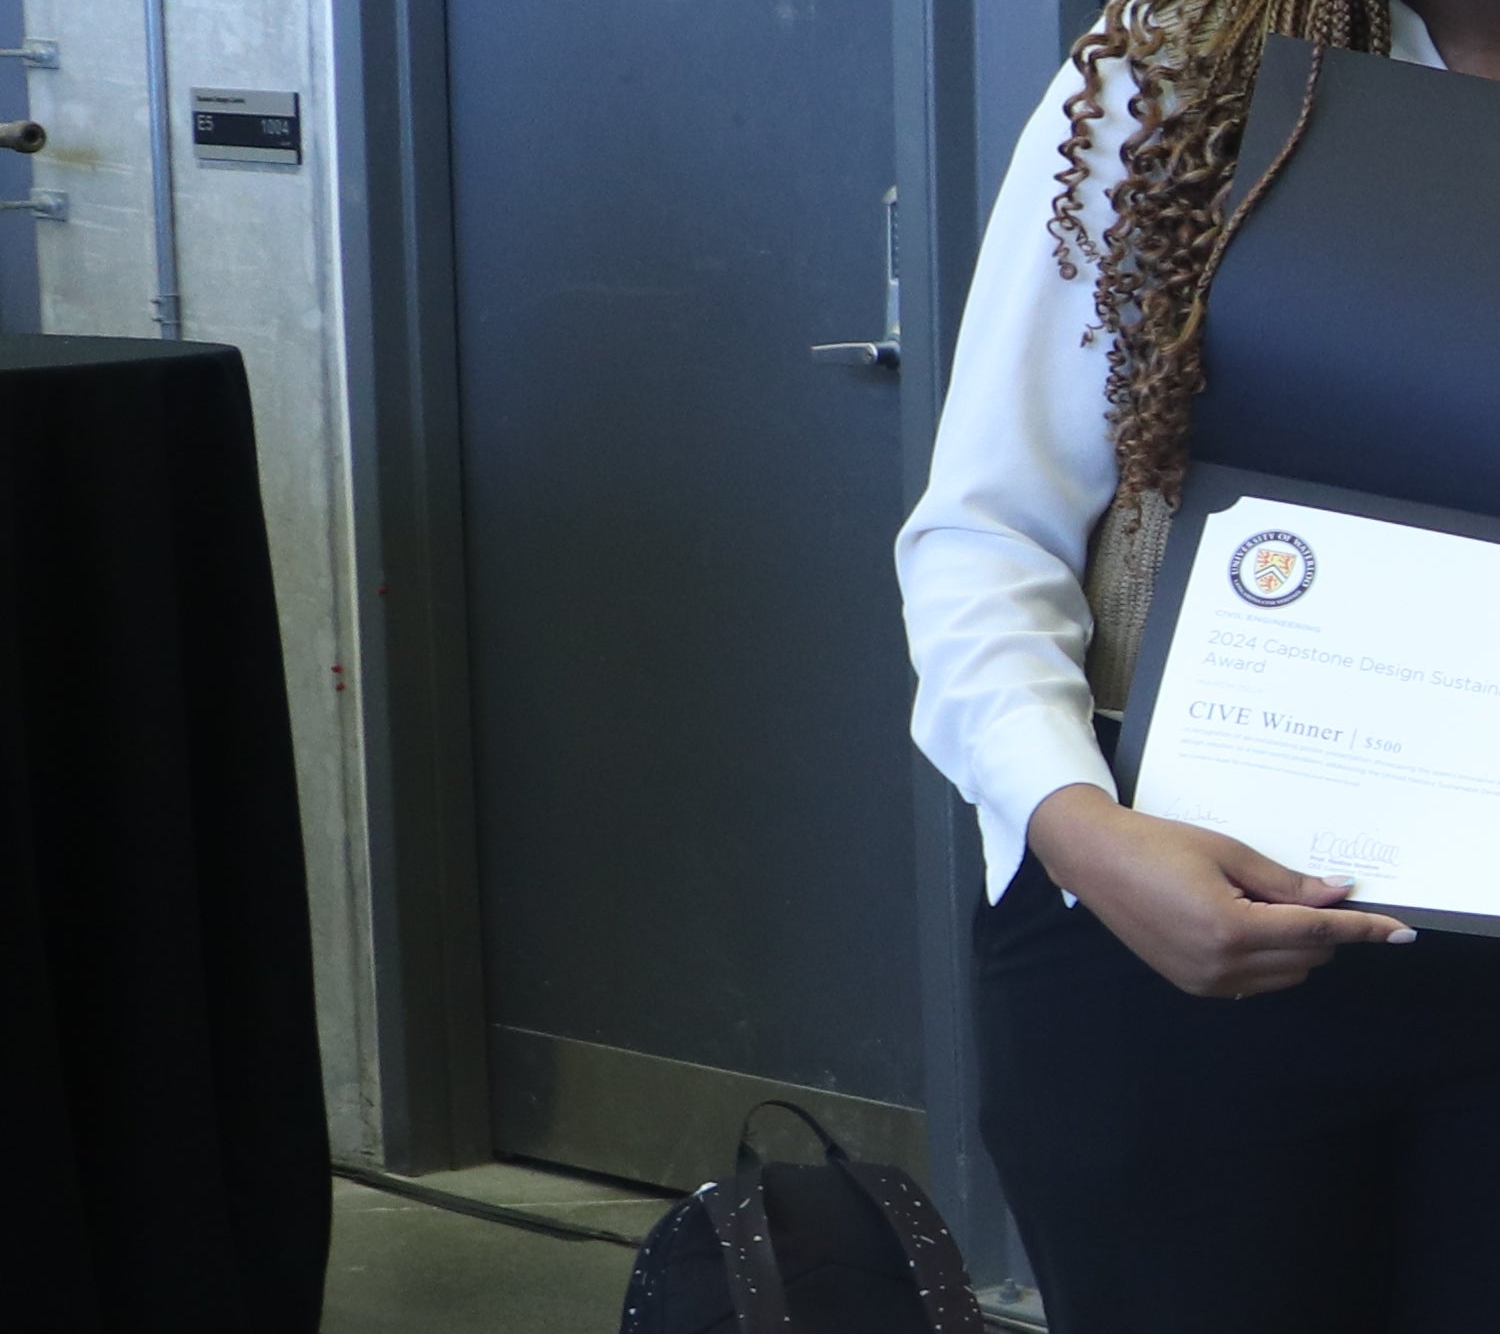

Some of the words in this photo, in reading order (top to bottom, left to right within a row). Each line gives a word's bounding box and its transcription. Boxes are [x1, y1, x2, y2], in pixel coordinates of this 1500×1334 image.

[197, 114, 214, 131] E5
[1231, 533, 1275, 575] UNIVERSITY
[1277, 533, 1291, 542] OF
[1202, 650, 1267, 675] Award
[1207, 629, 1258, 651] 2024
[1263, 638, 1355, 670] Capstone
[1359, 655, 1425, 685] Design
[1188, 699, 1252, 726] CIVE
[1261, 710, 1344, 743] Winner
[1363, 736, 1403, 755] $500
